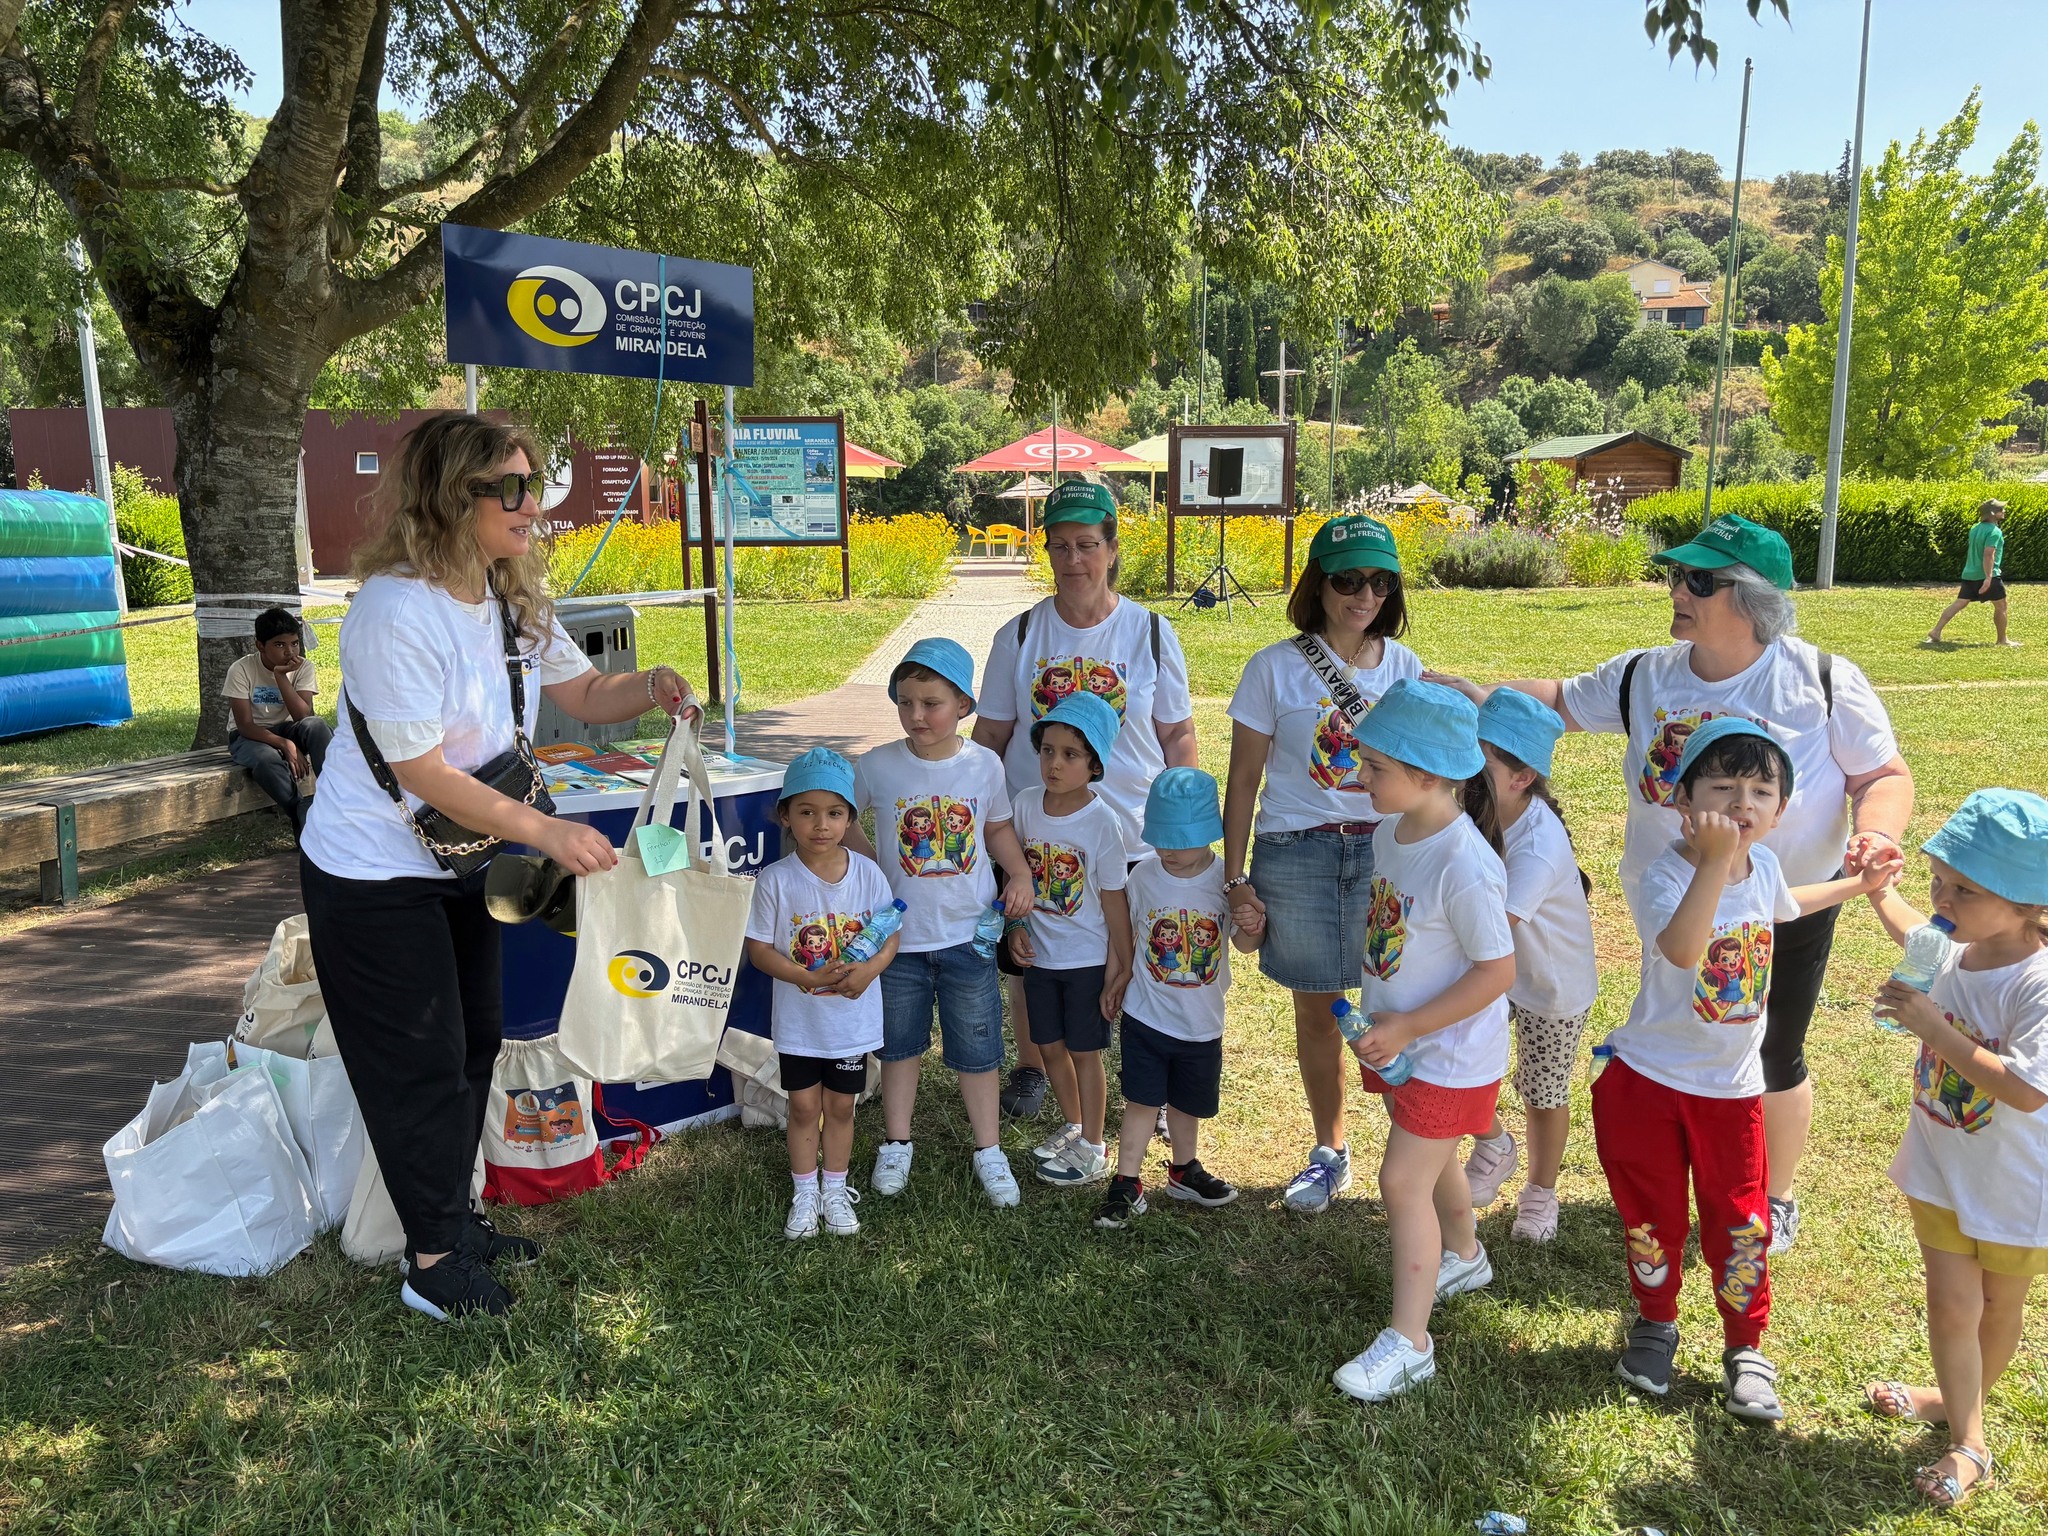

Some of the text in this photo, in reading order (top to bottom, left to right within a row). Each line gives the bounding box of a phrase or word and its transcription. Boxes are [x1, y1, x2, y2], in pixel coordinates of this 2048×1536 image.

[614, 279, 702, 318] CPCJ
[616, 314, 655, 324] COMISSÃO
[668, 319, 706, 330] PROTEÇÃO
[616, 324, 626, 332] DE
[678, 330, 706, 340] JOVENS
[616, 336, 707, 359] MIRANDELA
[753, 428, 801, 440] FLUVIAL
[553, 520, 574, 529] TUA
[1358, 531, 1386, 541] FRECHAS
[677, 960, 731, 985] CPCJ
[672, 994, 728, 1009] MIRANDELA
